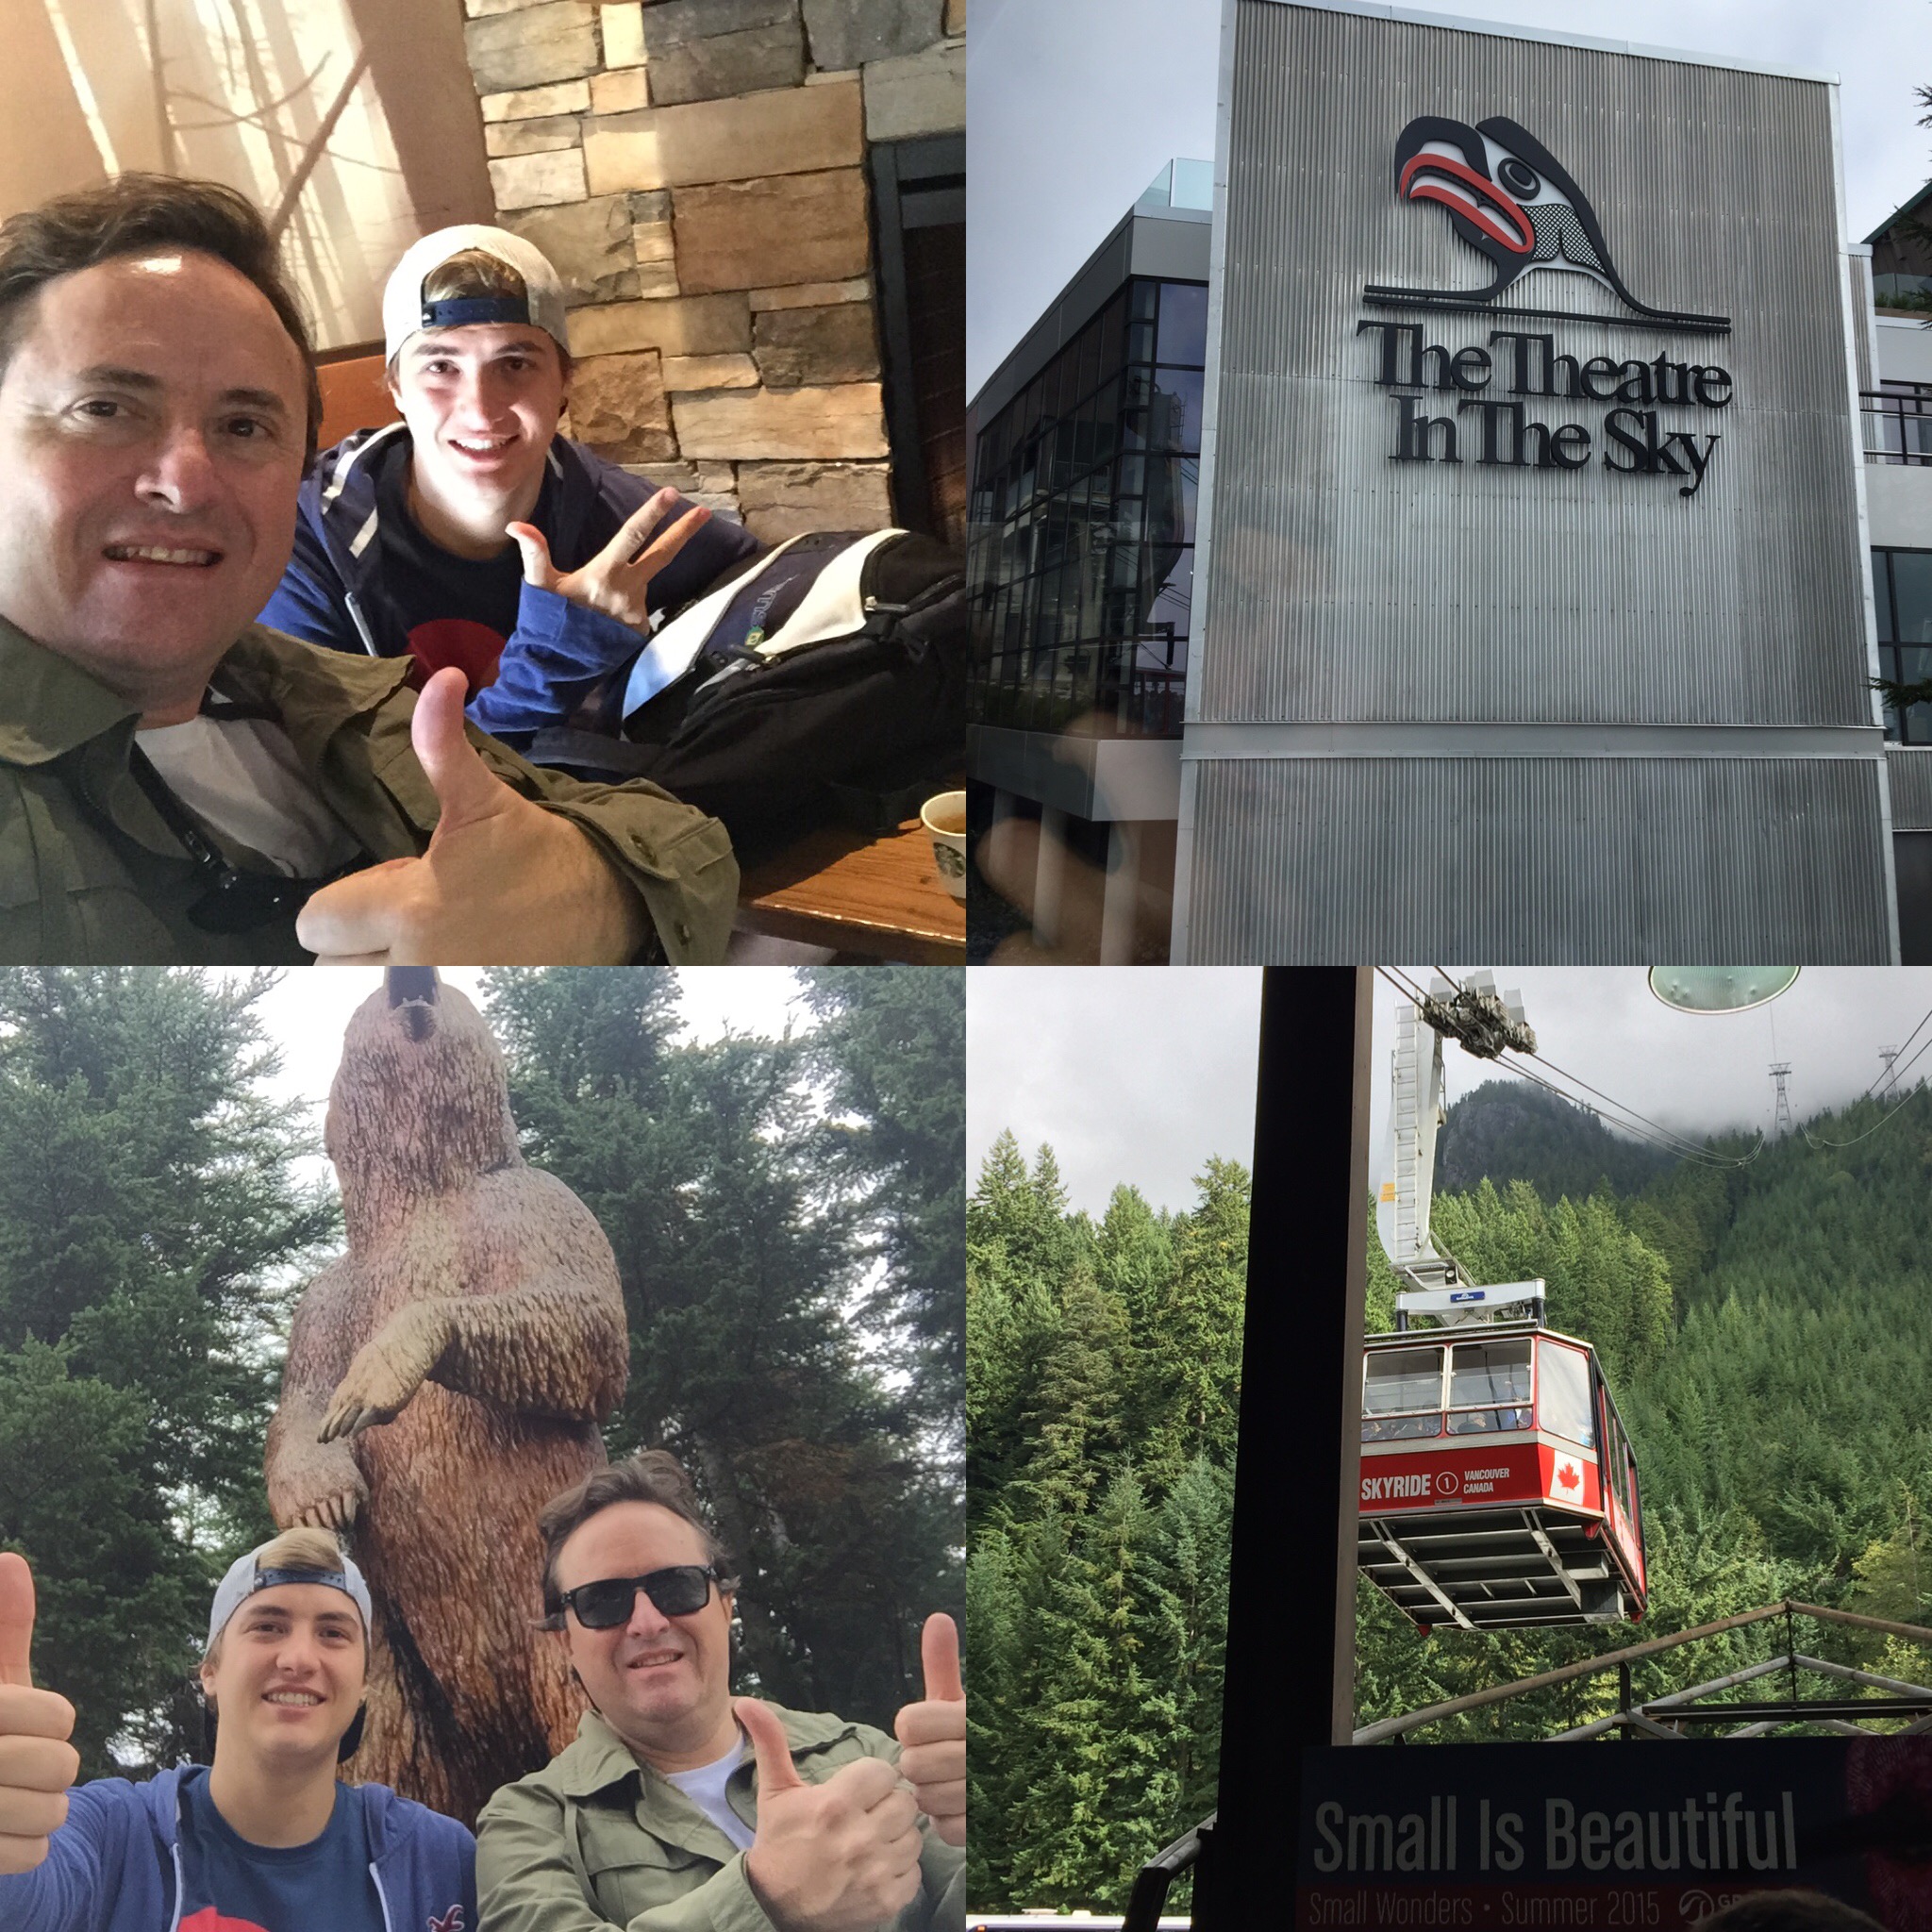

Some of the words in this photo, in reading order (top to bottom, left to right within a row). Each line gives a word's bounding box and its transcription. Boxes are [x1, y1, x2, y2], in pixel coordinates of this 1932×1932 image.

[1357, 320, 1491, 391] The
[1490, 330, 1732, 408] Theatre
[1389, 394, 1463, 462] In
[1457, 399, 1591, 469] The
[1604, 408, 1721, 497] Sky
[1360, 1474, 1431, 1500] SKYRIDE
[1463, 1482, 1493, 1494] CANADA
[1464, 1468, 1509, 1481] VANCOUVER
[1313, 1795, 1457, 1873] Small
[1479, 1798, 1524, 1872] Is
[1544, 1790, 1797, 1872] Beautiful
[1308, 1891, 1371, 1926] Small
[1374, 1890, 1473, 1926] Wonders
[1500, 1891, 1598, 1926] Summer
[1607, 1890, 1660, 1926] 2015
